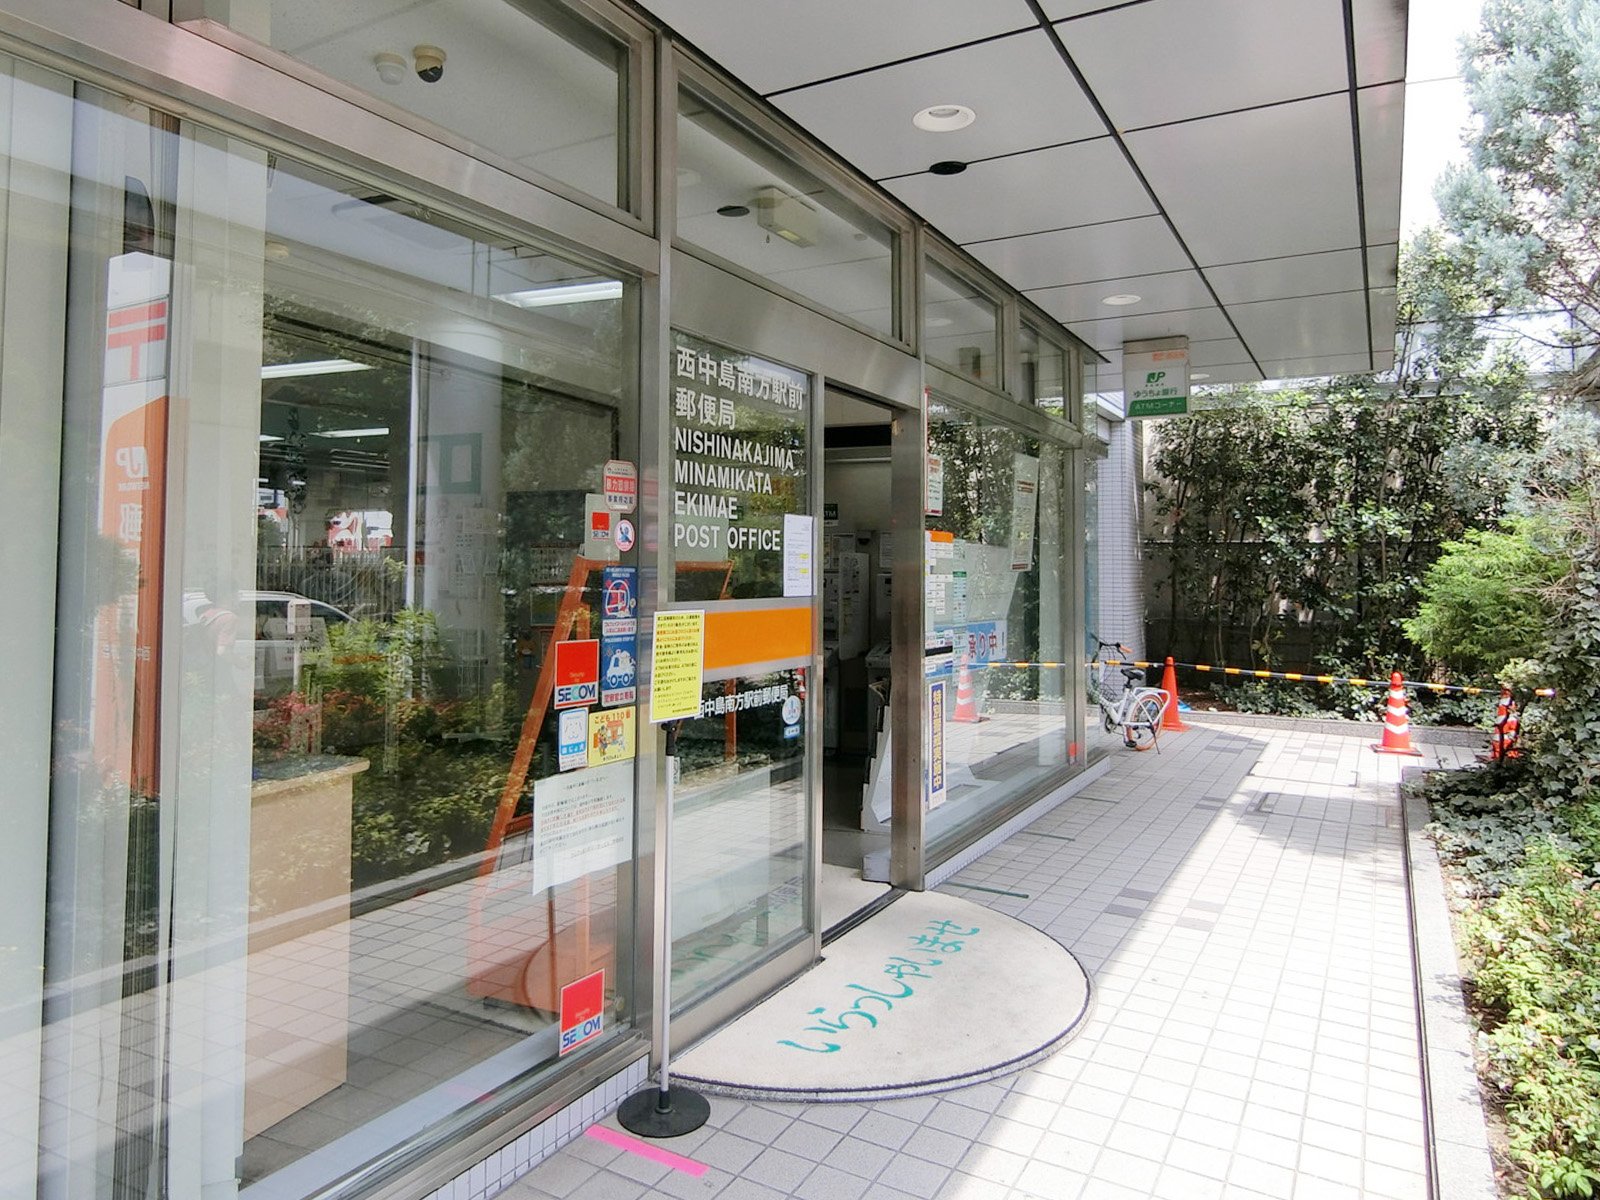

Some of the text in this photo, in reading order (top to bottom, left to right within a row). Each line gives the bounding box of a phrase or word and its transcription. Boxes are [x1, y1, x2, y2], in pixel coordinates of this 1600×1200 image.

[676, 345, 804, 410] 西中島南方駅前
[1133, 387, 1178, 398] ゆうちょ銀行
[675, 386, 736, 430] 郵便局
[1134, 402, 1182, 410] ATMコーナー
[675, 426, 794, 470] NISHINAKAJIMA
[675, 459, 772, 495] MINAMIKATA
[674, 491, 738, 520] EKIMAE
[674, 523, 781, 551] POST OFFICE
[558, 684, 596, 702] SECOM
[777, 920, 980, 1053] いらっしゃいませ
[562, 1015, 602, 1048] SECOM
